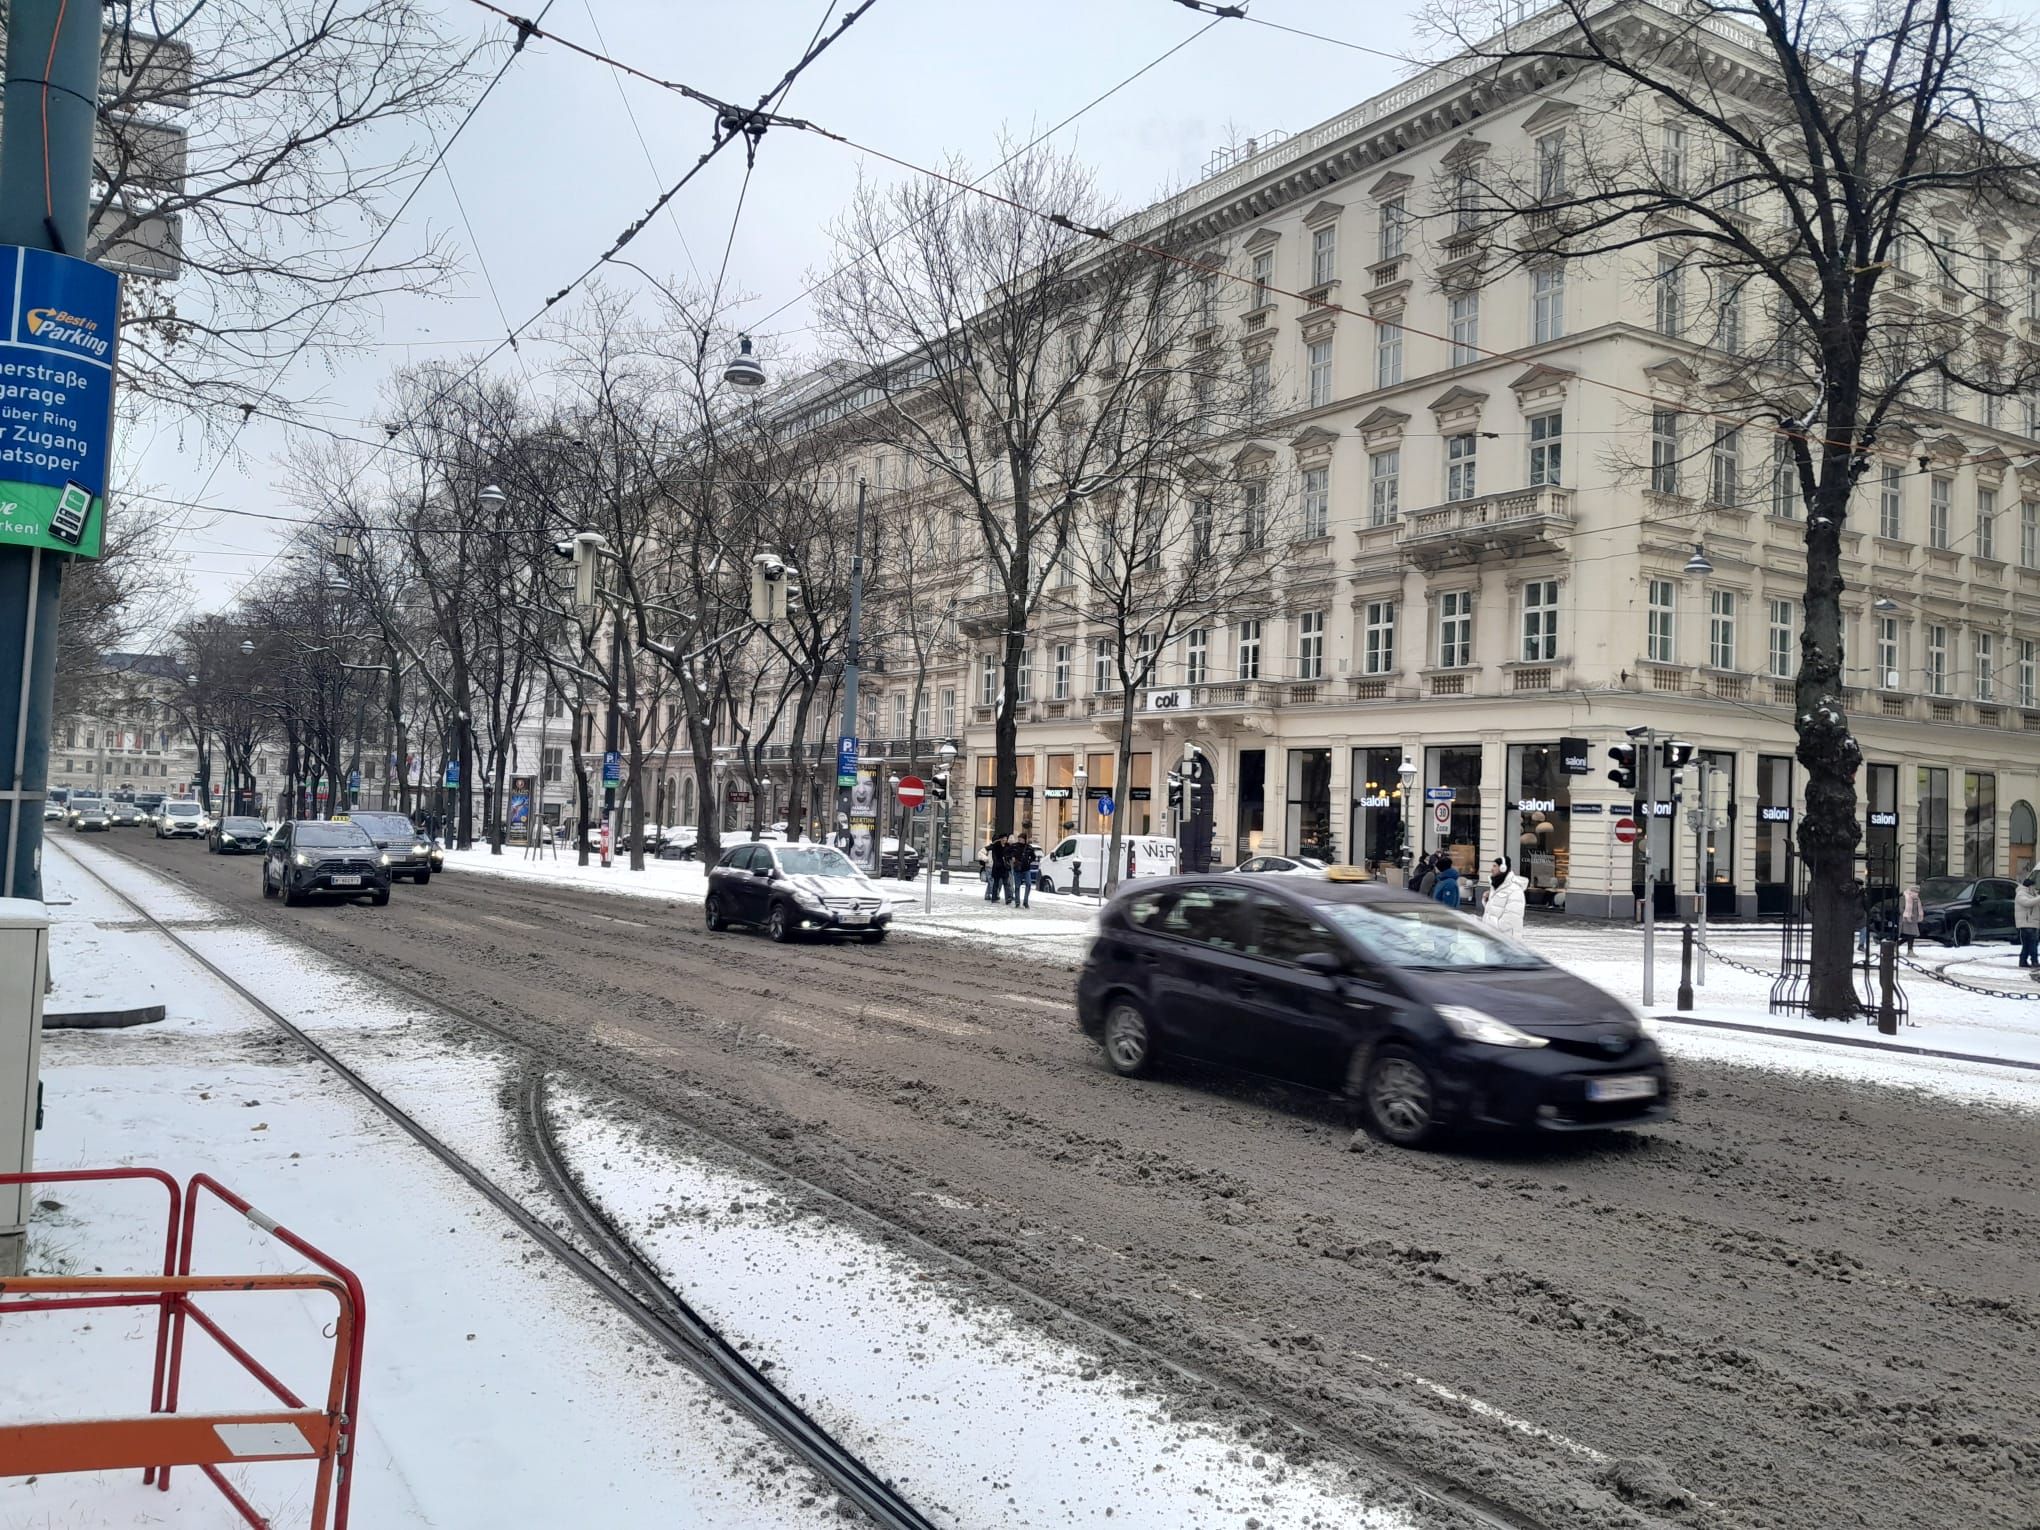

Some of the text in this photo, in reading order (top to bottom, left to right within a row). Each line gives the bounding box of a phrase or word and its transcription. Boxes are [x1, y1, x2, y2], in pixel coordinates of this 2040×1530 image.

[56, 311, 98, 331] Best in
[35, 320, 108, 356] Parking
[0, 362, 88, 390] erstraße
[2, 406, 77, 432] über Ring
[12, 424, 87, 457] Zugang
[0, 446, 80, 474] atsoper
[1155, 691, 1179, 708] colt
[1565, 755, 1587, 767] saloni
[1360, 795, 1390, 807] saloni
[1518, 797, 1555, 811] saloni
[1641, 801, 1672, 815] sloni
[1439, 807, 1447, 818] 30
[1762, 807, 1790, 821] saloni
[1871, 813, 1896, 825] saloni
[1436, 823, 1449, 832] Zone
